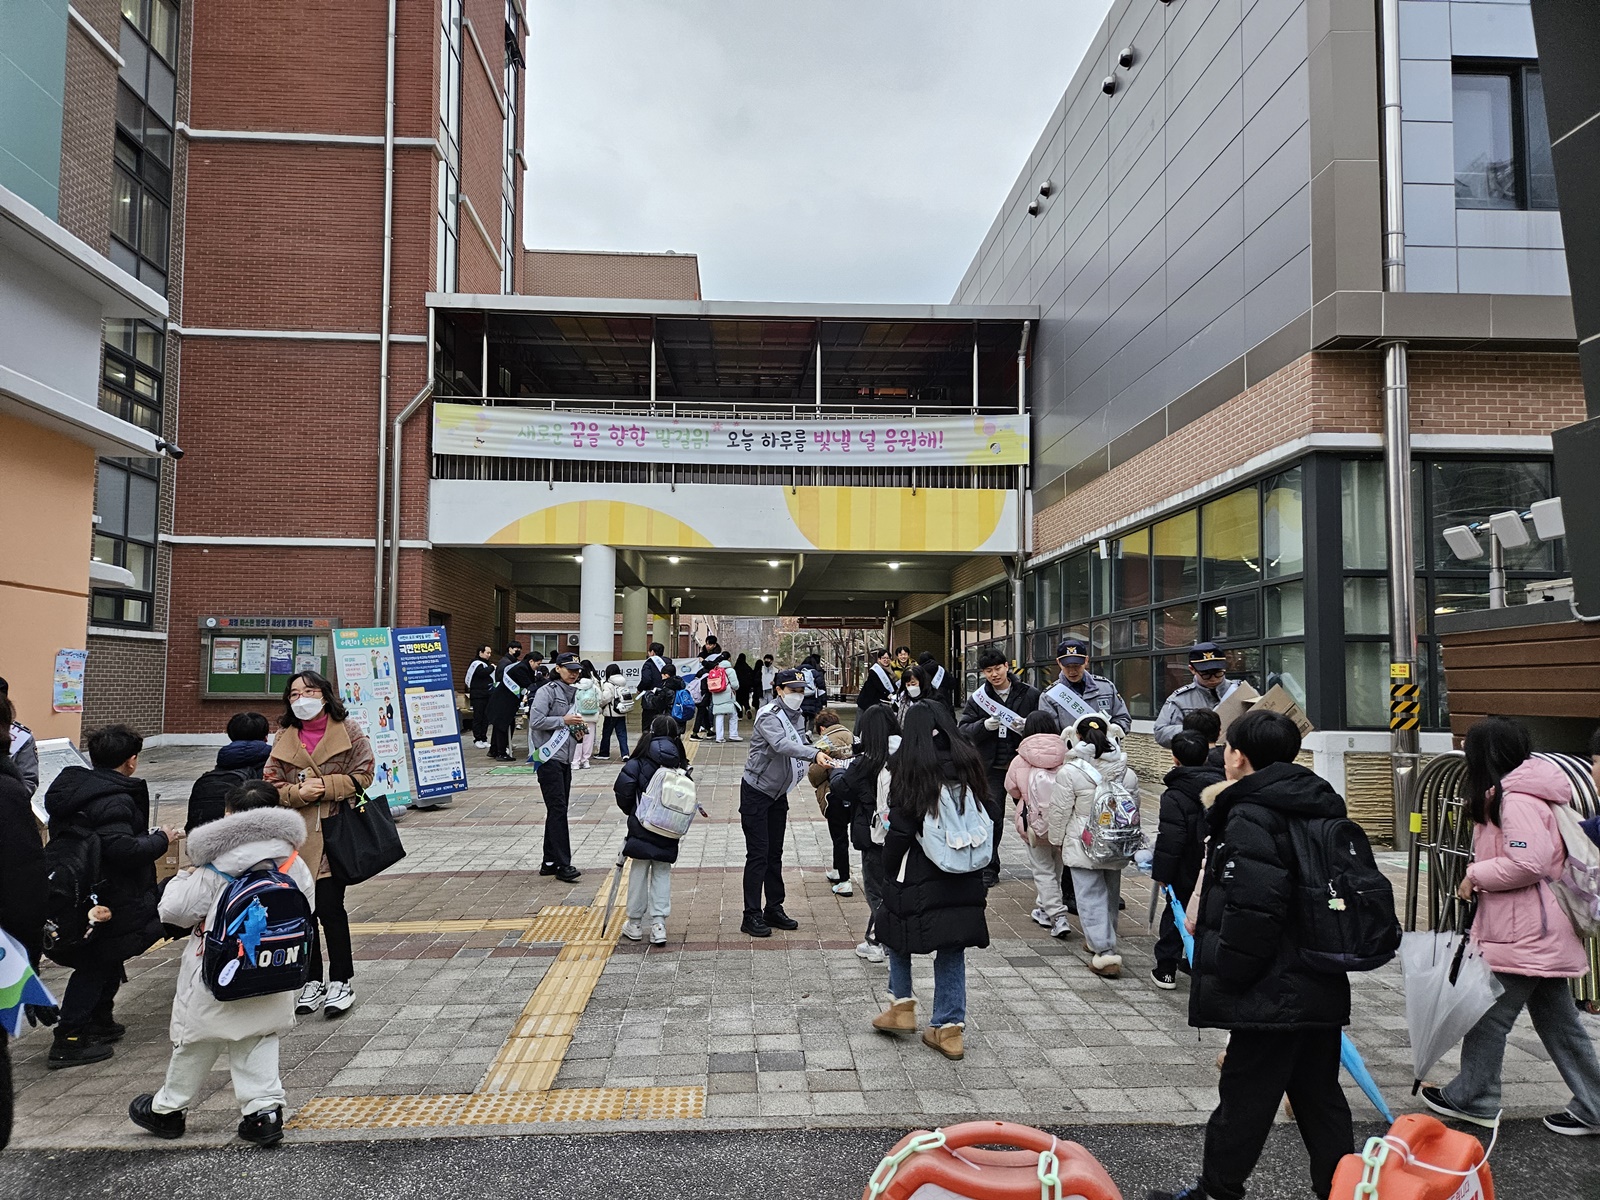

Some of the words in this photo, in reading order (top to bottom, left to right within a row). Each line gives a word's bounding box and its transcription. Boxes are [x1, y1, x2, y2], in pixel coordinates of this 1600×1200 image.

[517, 423, 564, 446] 새로운
[570, 421, 600, 448] 꿈을
[608, 424, 650, 448] 향한
[654, 427, 710, 450] 발걸음!
[726, 428, 755, 452] 오늘
[760, 429, 807, 452] 하루를
[813, 429, 852, 452] 빛낼
[858, 429, 876, 452] 널
[883, 428, 944, 452] 응원해!
[362, 636, 386, 646] 안전수칙
[399, 641, 442, 654] 국민안전수칙
[242, 945, 300, 970] OON
